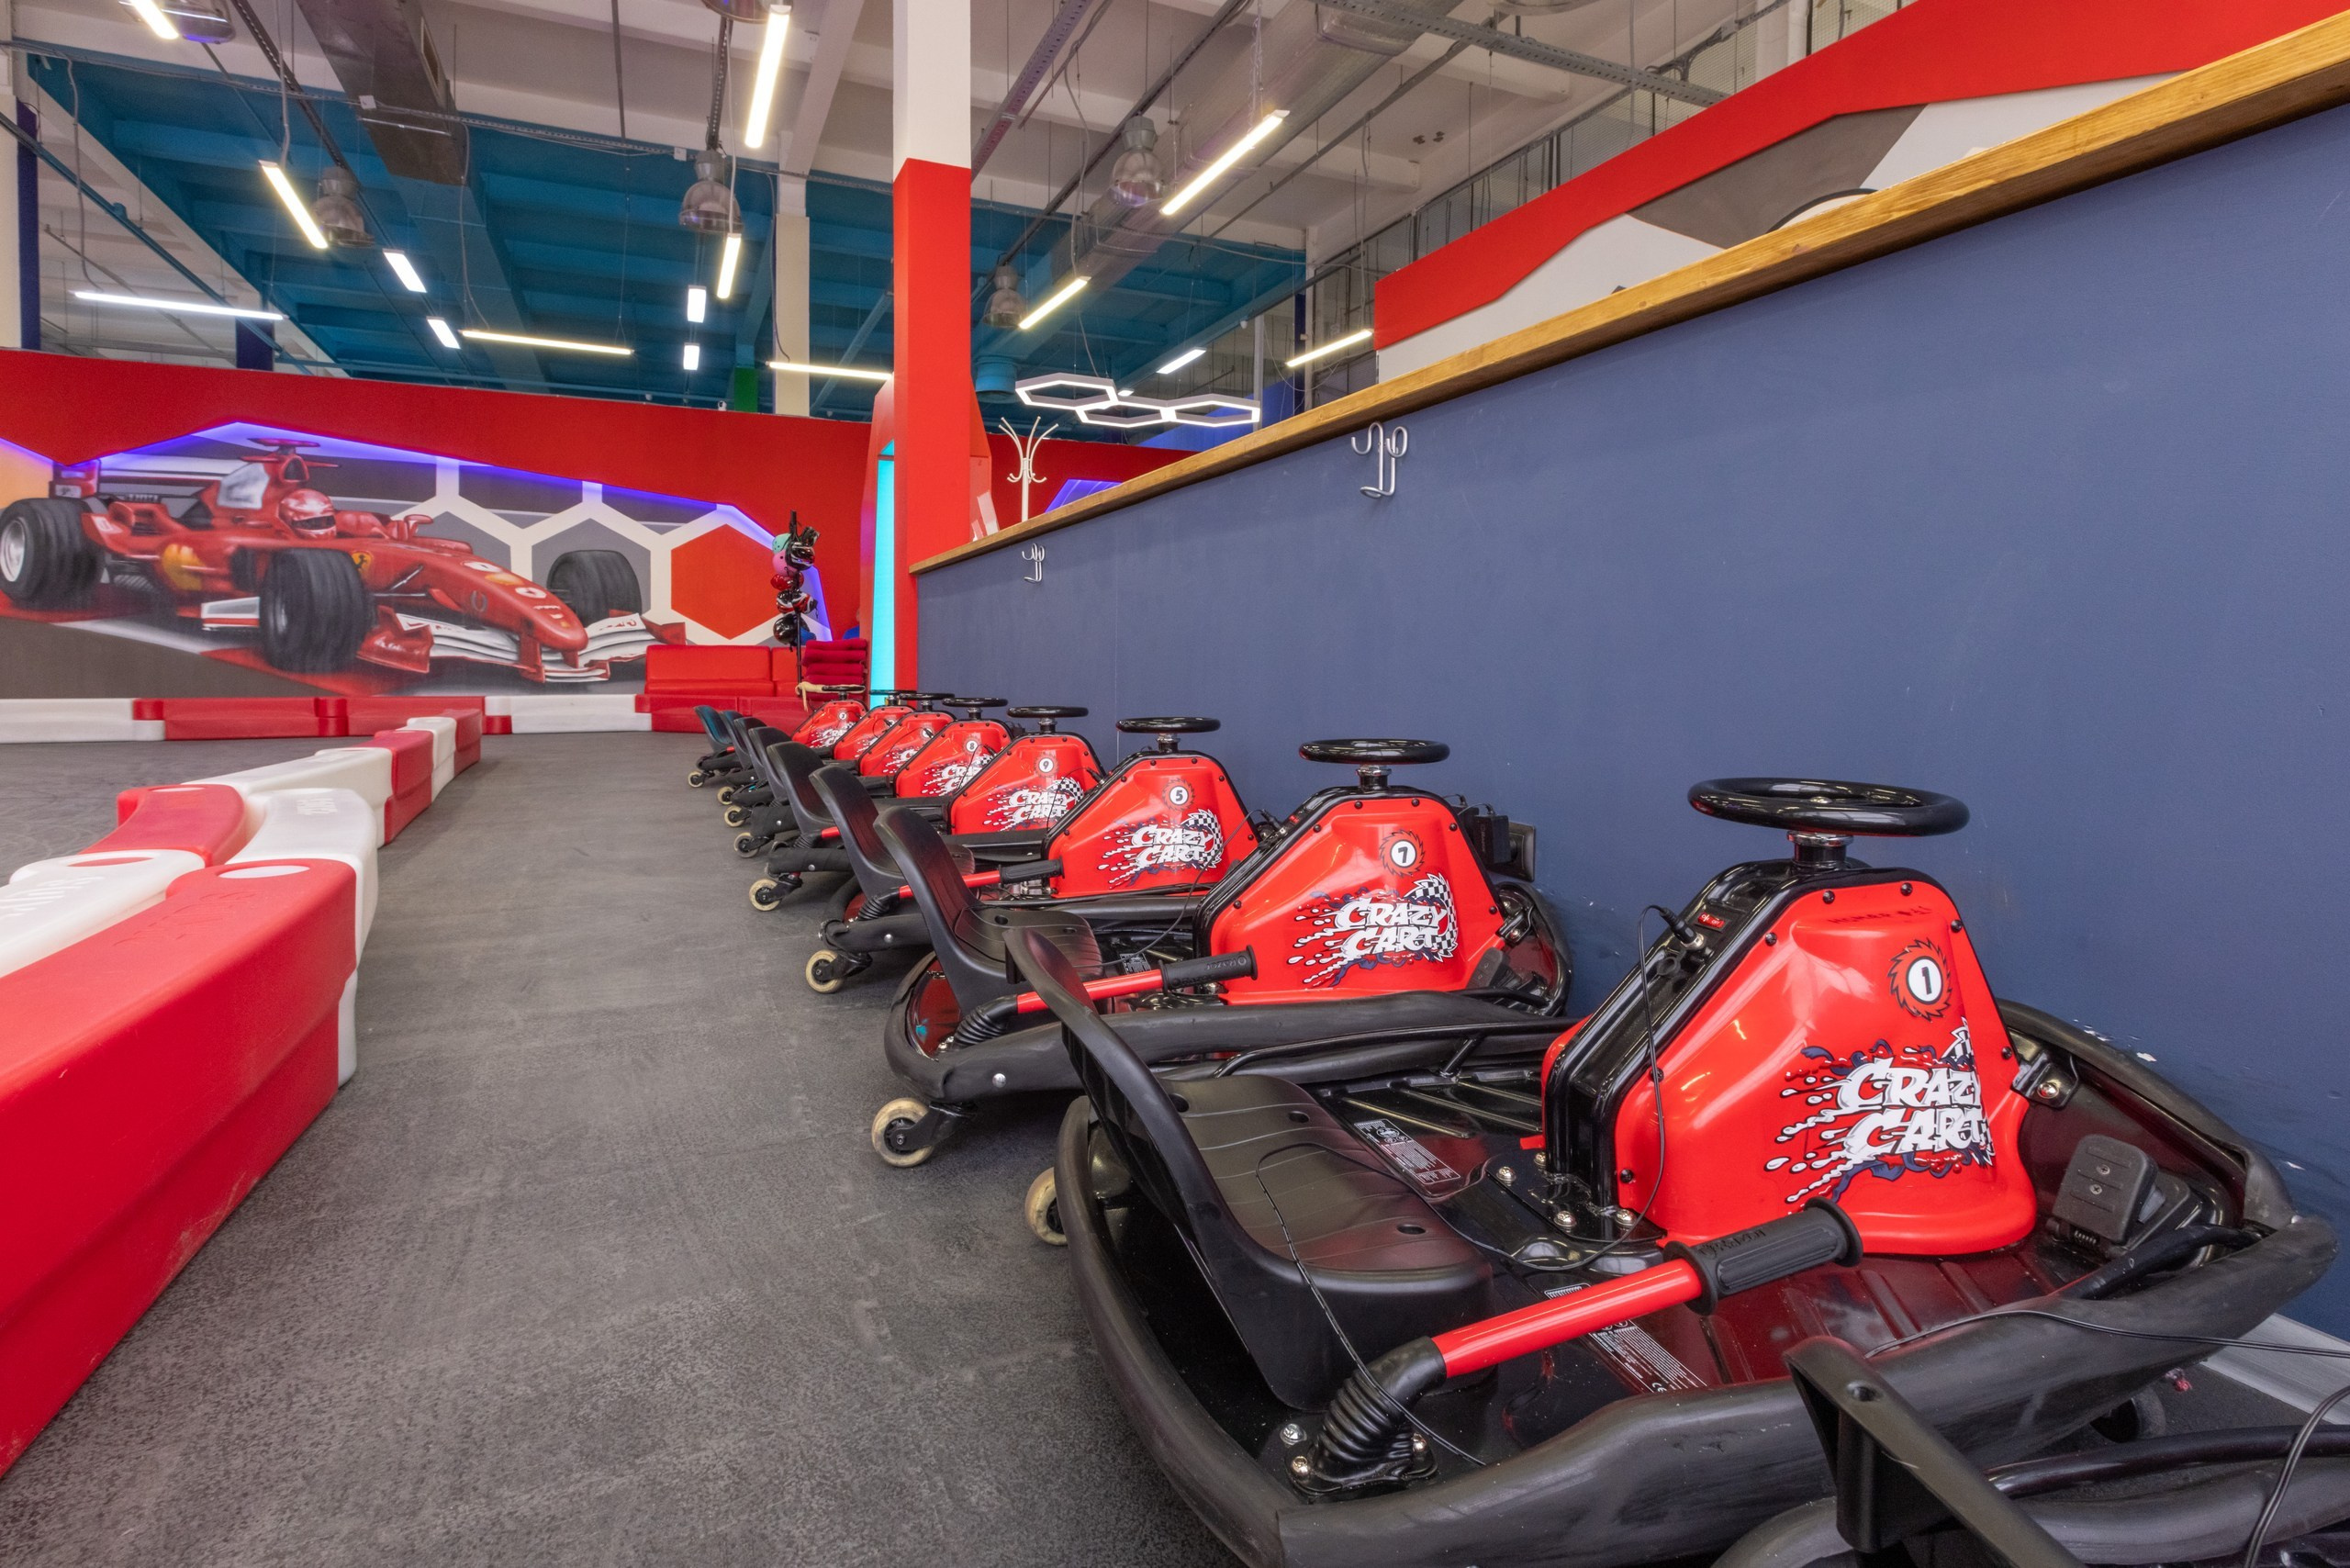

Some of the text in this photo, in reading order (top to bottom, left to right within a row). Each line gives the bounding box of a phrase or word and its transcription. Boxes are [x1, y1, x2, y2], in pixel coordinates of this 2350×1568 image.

[969, 742, 975, 750] 8
[1043, 760, 1049, 770] 9
[1009, 789, 1076, 807] CRAZY
[1175, 790, 1183, 801] 5
[1132, 824, 1214, 846] CRAZY
[1136, 843, 1205, 868] CART
[1397, 846, 1408, 864] 7
[1334, 898, 1448, 931] CRAZY
[1340, 925, 1439, 958] CART
[1921, 966, 1932, 995] 1
[1843, 1107, 1984, 1159] CART
